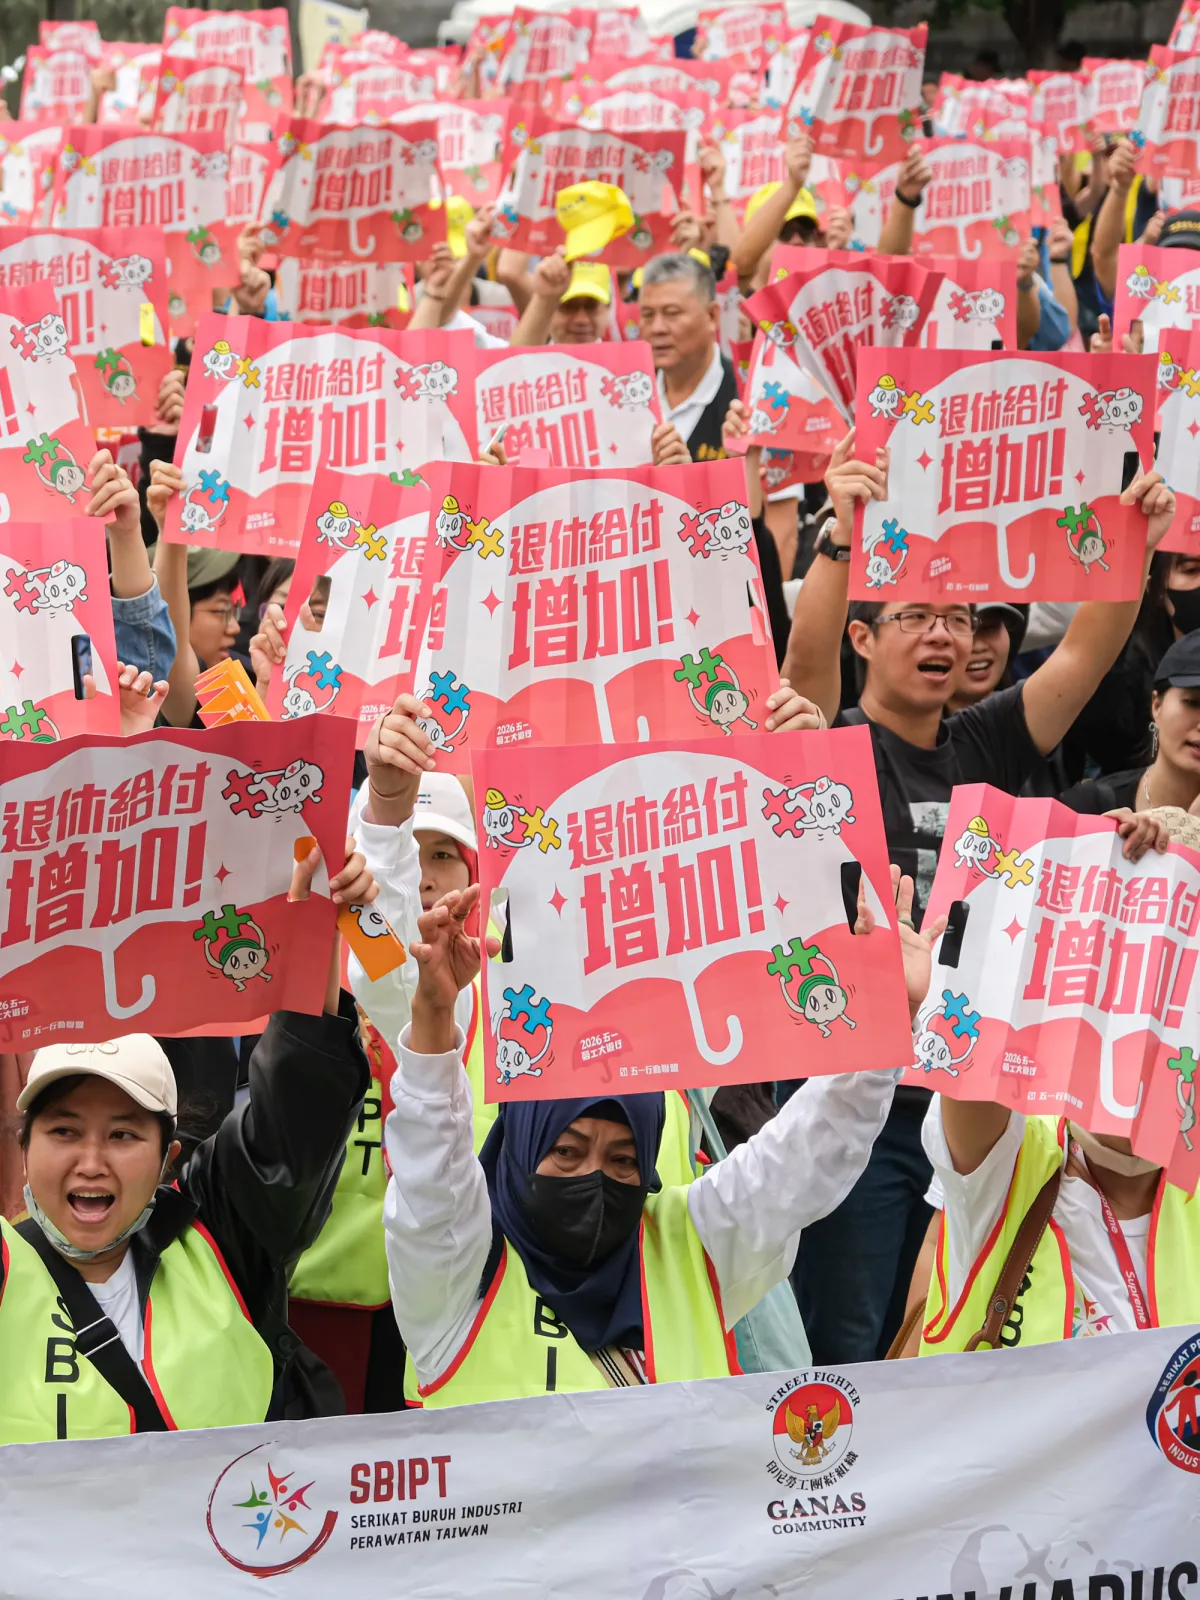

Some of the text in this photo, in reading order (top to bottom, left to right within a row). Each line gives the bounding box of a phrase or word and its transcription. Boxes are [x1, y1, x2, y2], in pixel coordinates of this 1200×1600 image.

[263, 351, 386, 404] 退休給付
[481, 367, 588, 424] 退休給付
[938, 377, 1069, 438] 退休給付
[259, 397, 387, 474] 增加!
[937, 428, 1067, 516] 增加!
[509, 498, 665, 577] 退休給付
[507, 558, 676, 672] 增加!
[0, 760, 211, 854] 退休給付
[567, 770, 749, 870] 退休給付
[0, 821, 208, 948] 增加!
[580, 838, 767, 976] 增加!
[1036, 859, 1200, 933] 退休給付
[1023, 916, 1199, 1030] 增加!
[580, 1032, 620, 1050] 2026五一
[580, 1039, 624, 1063] 勞工大遊行
[1124, 1270, 1147, 1324] Supreme
[765, 1371, 861, 1413] STREET FIGHTER
[1158, 1348, 1190, 1392] SERIKAT
[350, 1455, 452, 1505] SBIPT
[765, 1451, 860, 1492] 印尼勞工團結組織
[1168, 1442, 1200, 1468] INDUS
[351, 1501, 523, 1529] SERIKAT BURUH INDUSTRI
[766, 1492, 867, 1521] GANAS
[772, 1516, 867, 1535] COMMUNITY
[350, 1523, 489, 1550] PERAWATAN TAIWAN
